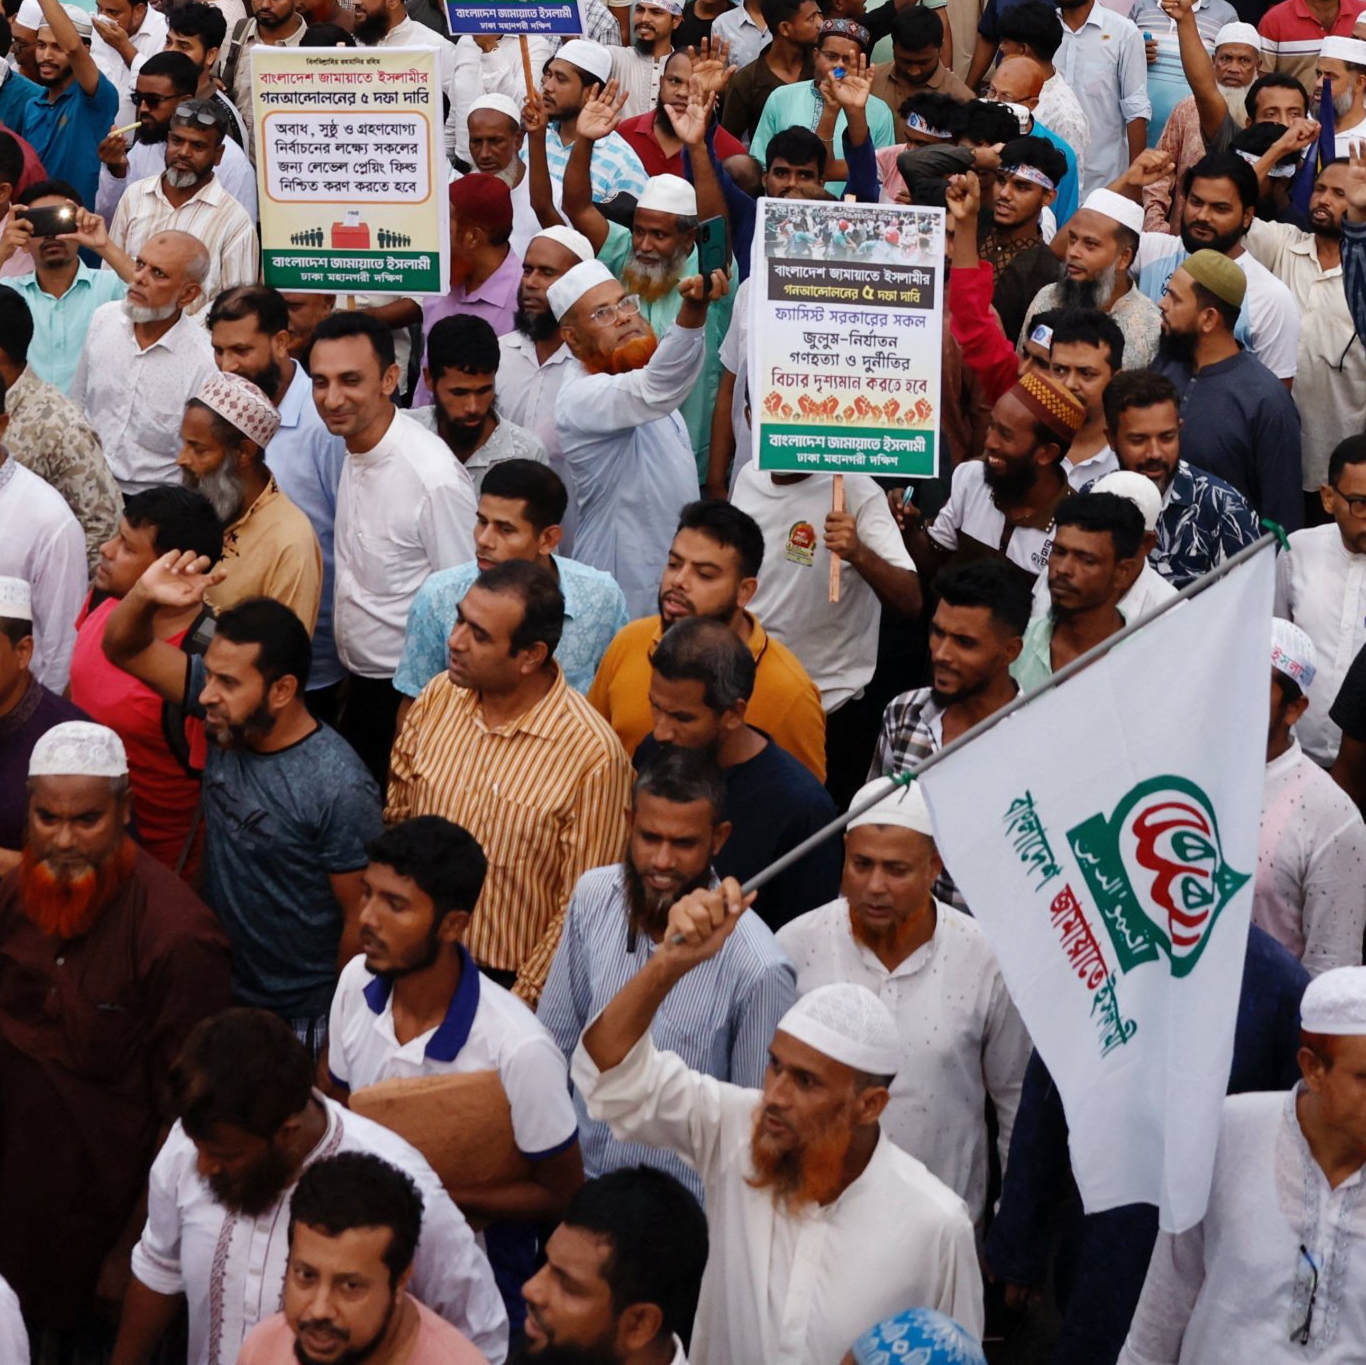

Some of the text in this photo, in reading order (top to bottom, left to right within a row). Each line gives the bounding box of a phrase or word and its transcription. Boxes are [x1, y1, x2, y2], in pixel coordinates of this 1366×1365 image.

[455, 5, 571, 19] বাংলাদেশ জামায়াতে ইসলামী
[259, 68, 428, 84] বাংলাদেশ জামায়াতে ইসলামীর
[360, 92, 368, 103] ৫
[372, 90, 398, 104] দফা
[402, 86, 429, 103] দাবি
[318, 120, 338, 139] সুষ্ঠু
[343, 124, 353, 134] ও
[356, 123, 416, 135] গ্রহণযোগ্য
[274, 138, 418, 154] নির্বাচনের লক্ষ্যে সকলের
[277, 158, 417, 175] জন্য লেভেল প্লেয়িং ফিল্ড
[279, 176, 416, 192] নিশ্চিত করণ করতে হবে
[271, 255, 430, 270] বাংলাদেশ জামায়াতে ইসলামী
[300, 271, 403, 282] ঢাকা মহানগরী দক্ষিণ
[1003, 790, 1063, 893] বাংলাদেশ
[1049, 882, 1108, 990] জামায়াতে
